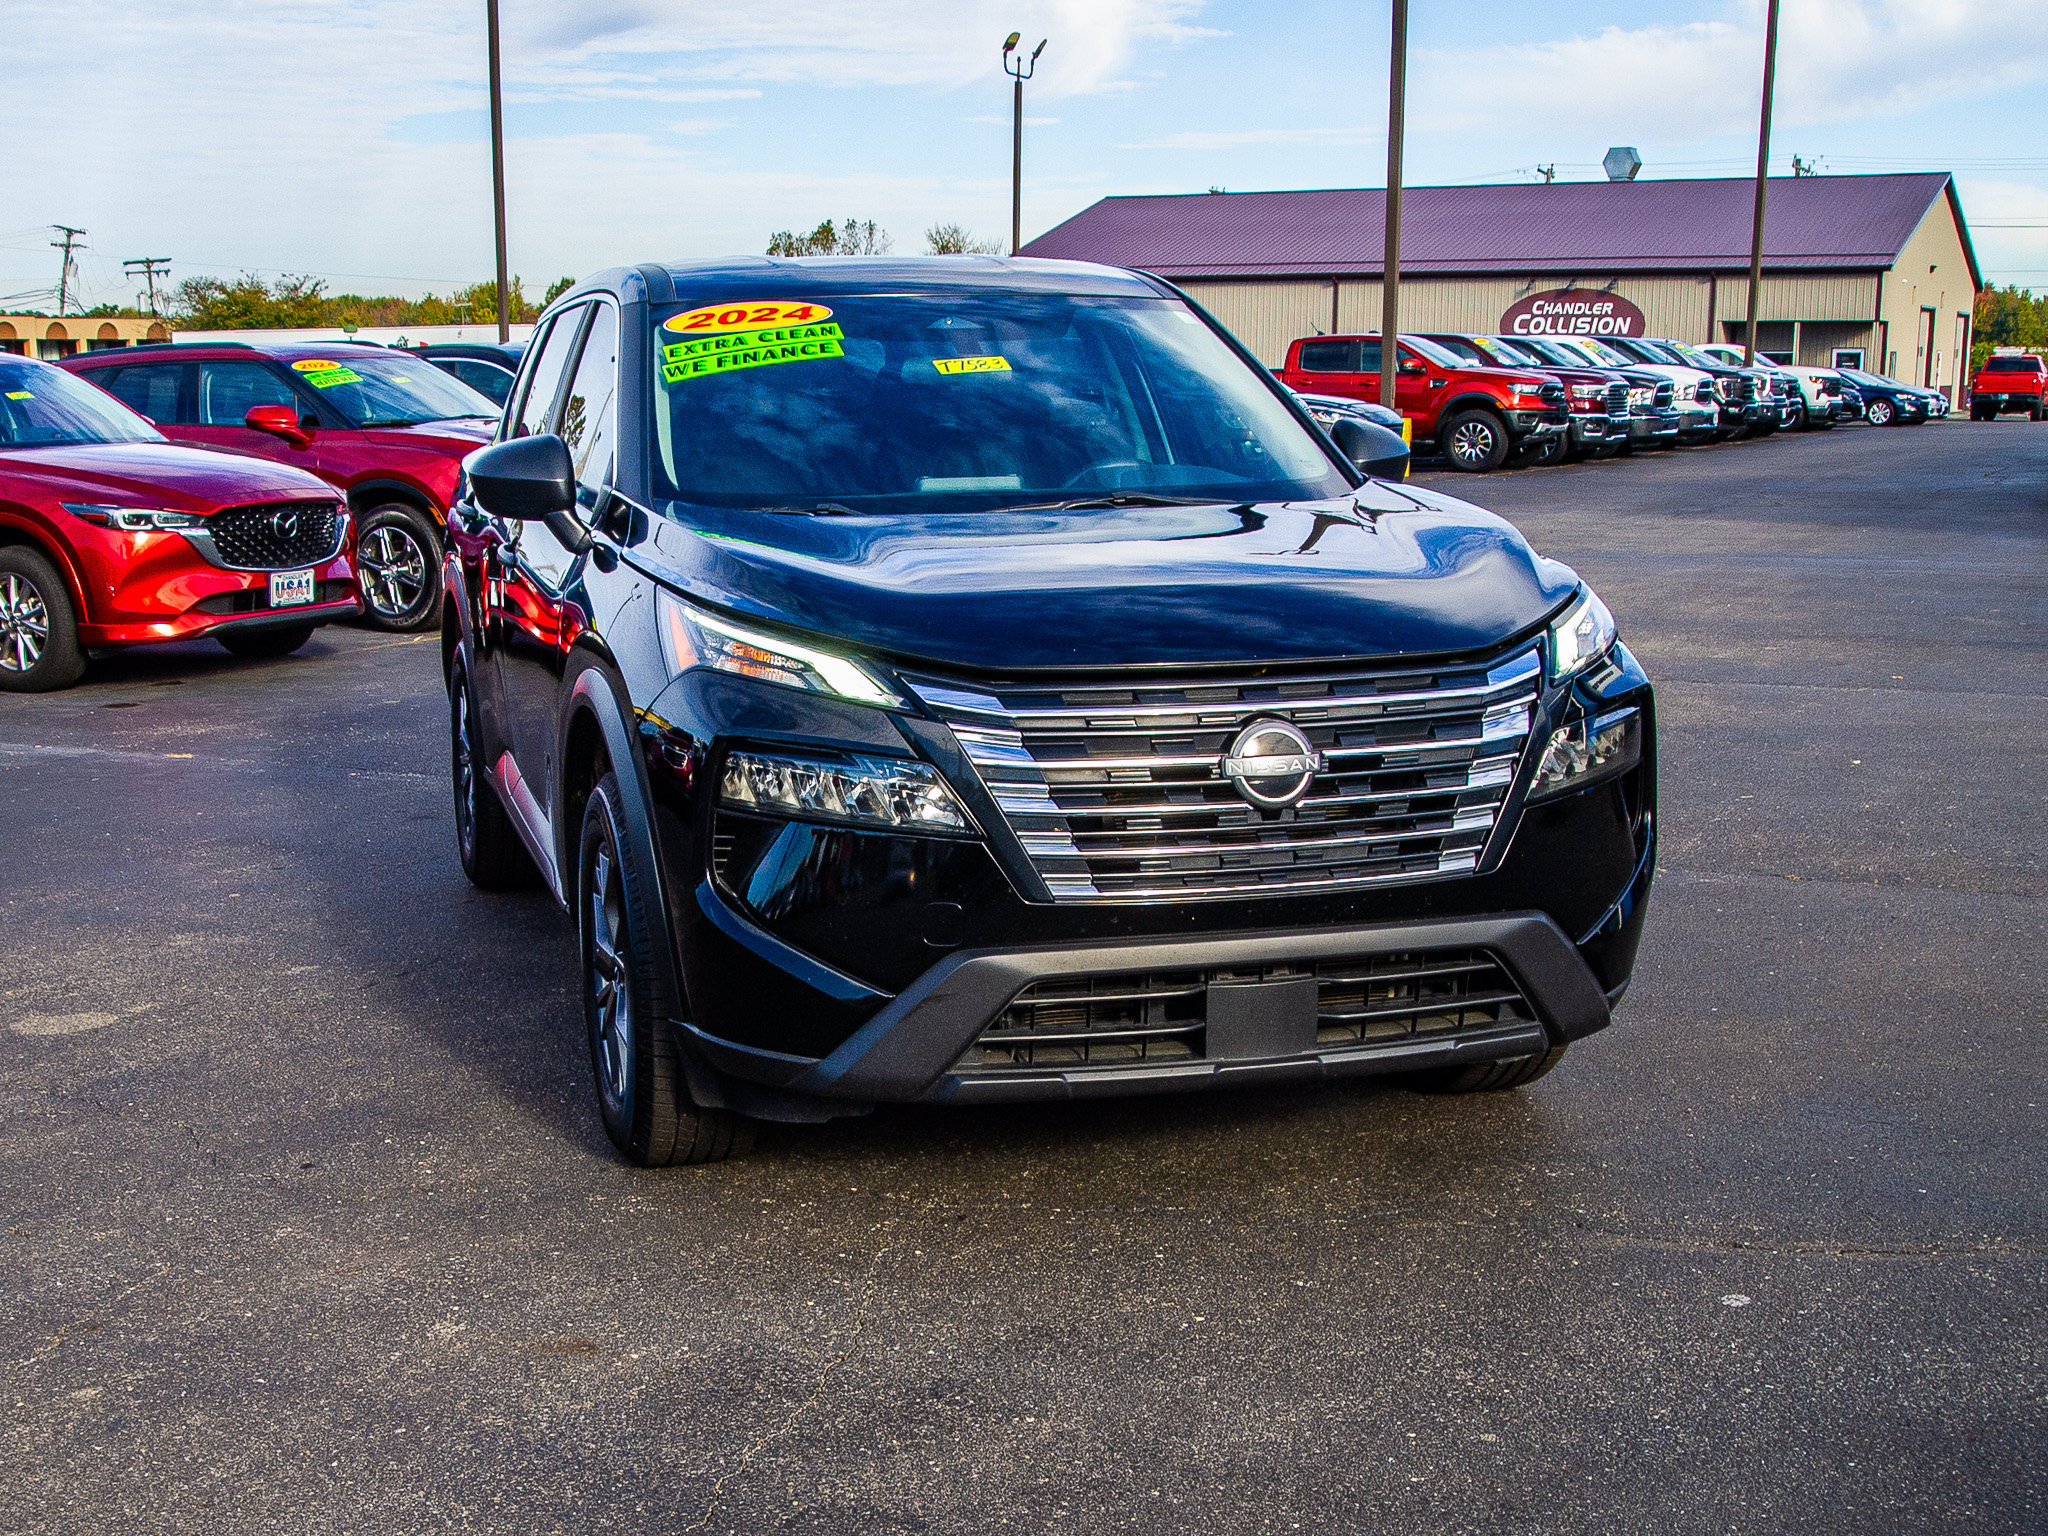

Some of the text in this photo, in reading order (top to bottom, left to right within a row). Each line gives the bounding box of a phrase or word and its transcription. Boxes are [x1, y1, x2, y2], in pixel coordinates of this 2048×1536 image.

[682, 305, 815, 331] 2024
[1532, 300, 1614, 315] CHANDLER
[1513, 314, 1632, 335] COLLISION
[668, 325, 837, 359] EXTRA CLEAN
[666, 342, 836, 378] WE FINANCE
[1227, 757, 1319, 774] NISSAN
